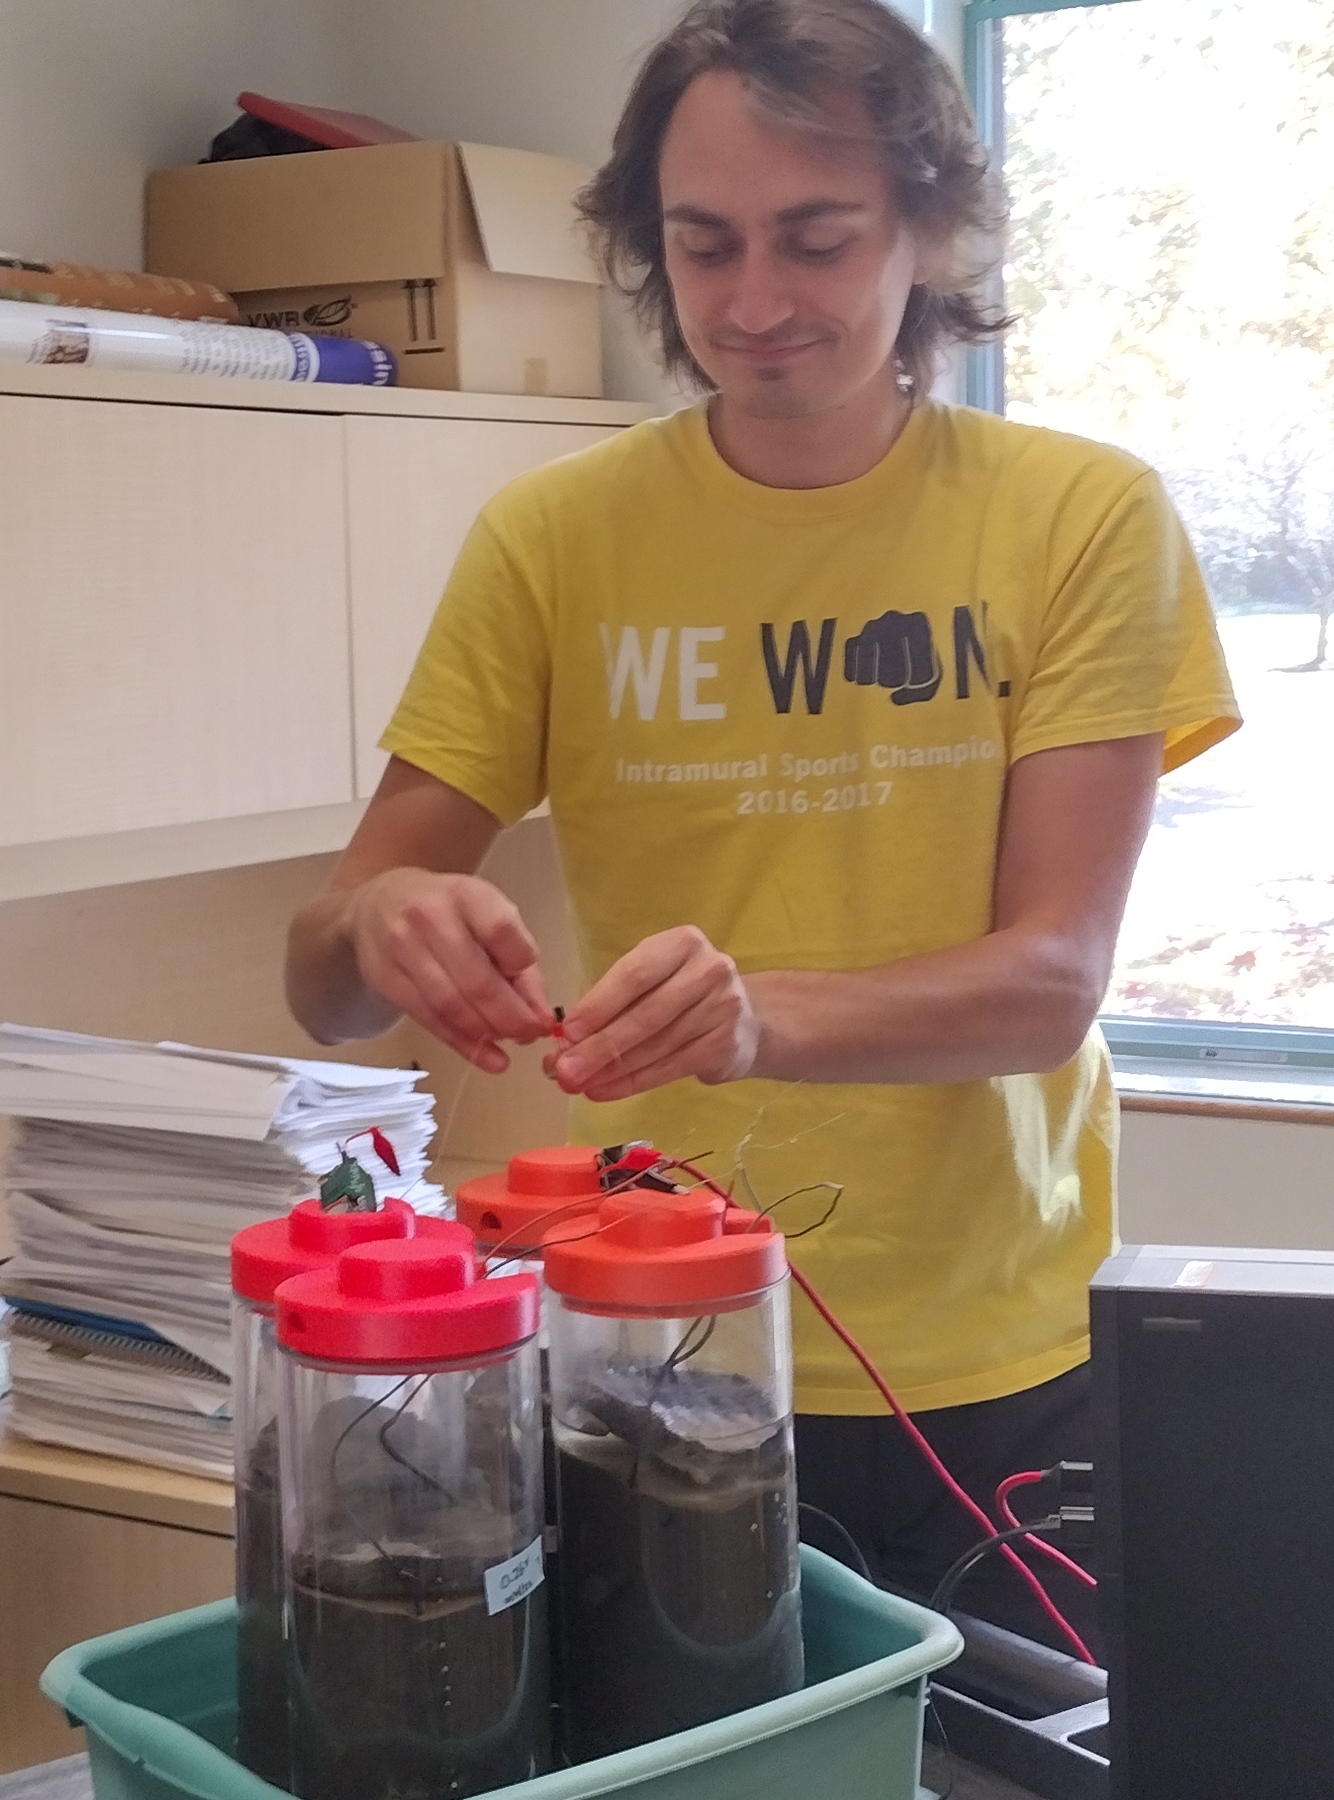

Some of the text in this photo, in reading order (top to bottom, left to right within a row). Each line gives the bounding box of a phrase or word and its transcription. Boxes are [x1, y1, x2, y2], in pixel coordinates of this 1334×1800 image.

[247, 311, 301, 328] VWR
[599, 622, 727, 721] WE
[615, 754, 768, 784] Intramural
[779, 751, 859, 782] Sports
[736, 781, 894, 816] 2016-2017
